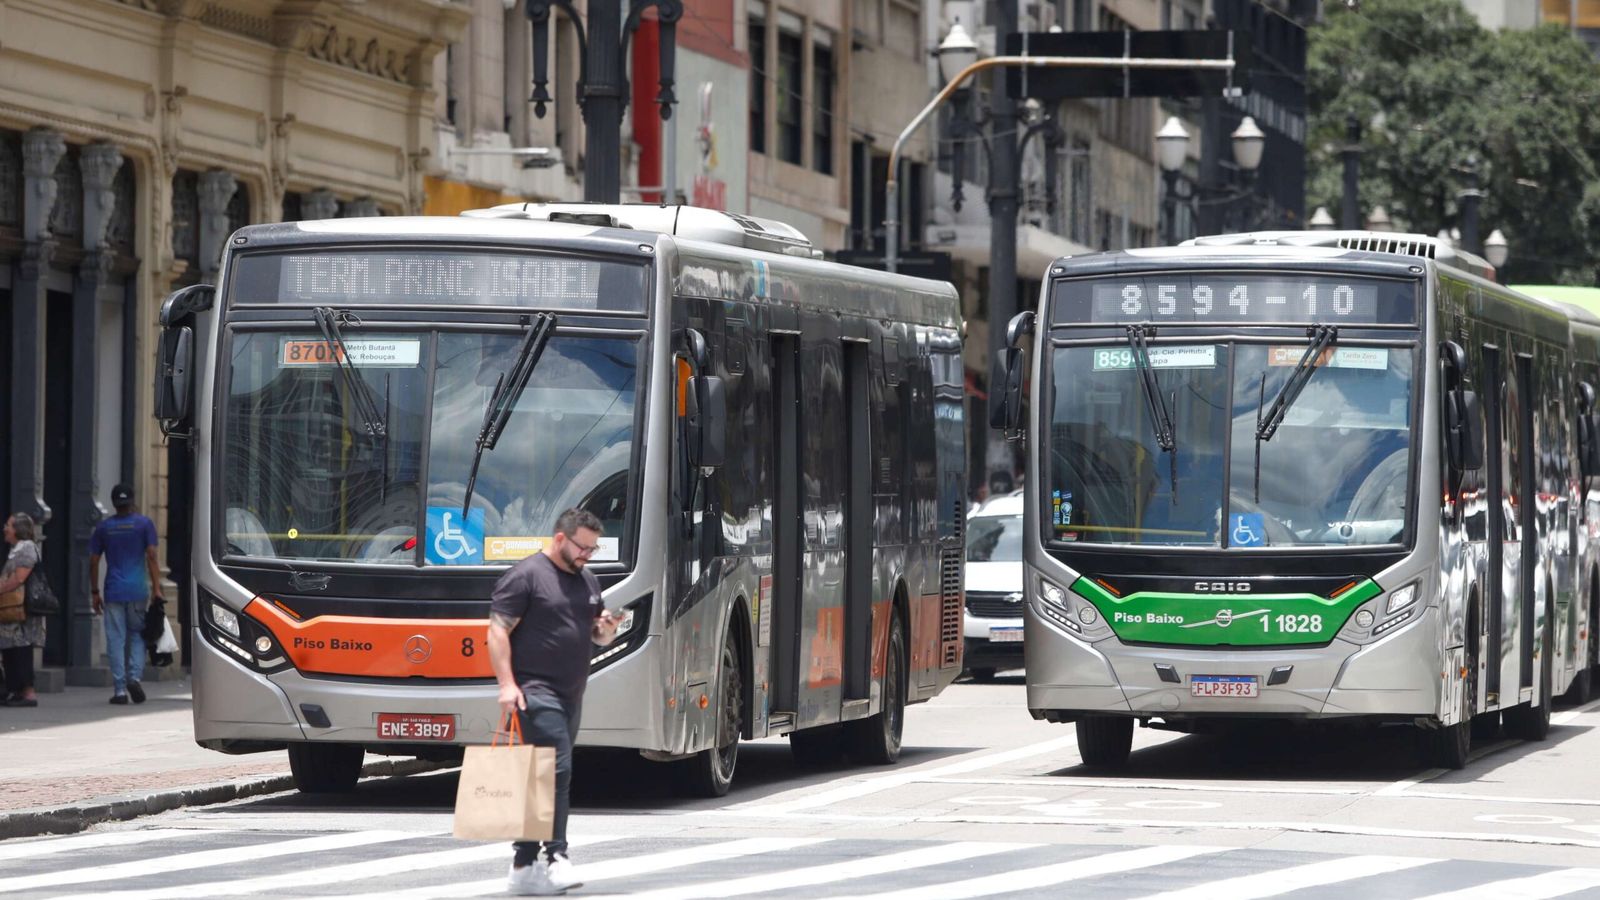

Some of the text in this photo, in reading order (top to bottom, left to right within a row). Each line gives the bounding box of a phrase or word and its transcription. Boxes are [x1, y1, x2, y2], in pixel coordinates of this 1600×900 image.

[385, 258, 481, 297] PRINC.
[490, 260, 598, 298] ISABEL
[359, 353, 396, 361] Rebouças
[1194, 582, 1251, 592] CAIO
[1114, 612, 1184, 624] Piso Baixo
[293, 637, 373, 652] Piso Baixo
